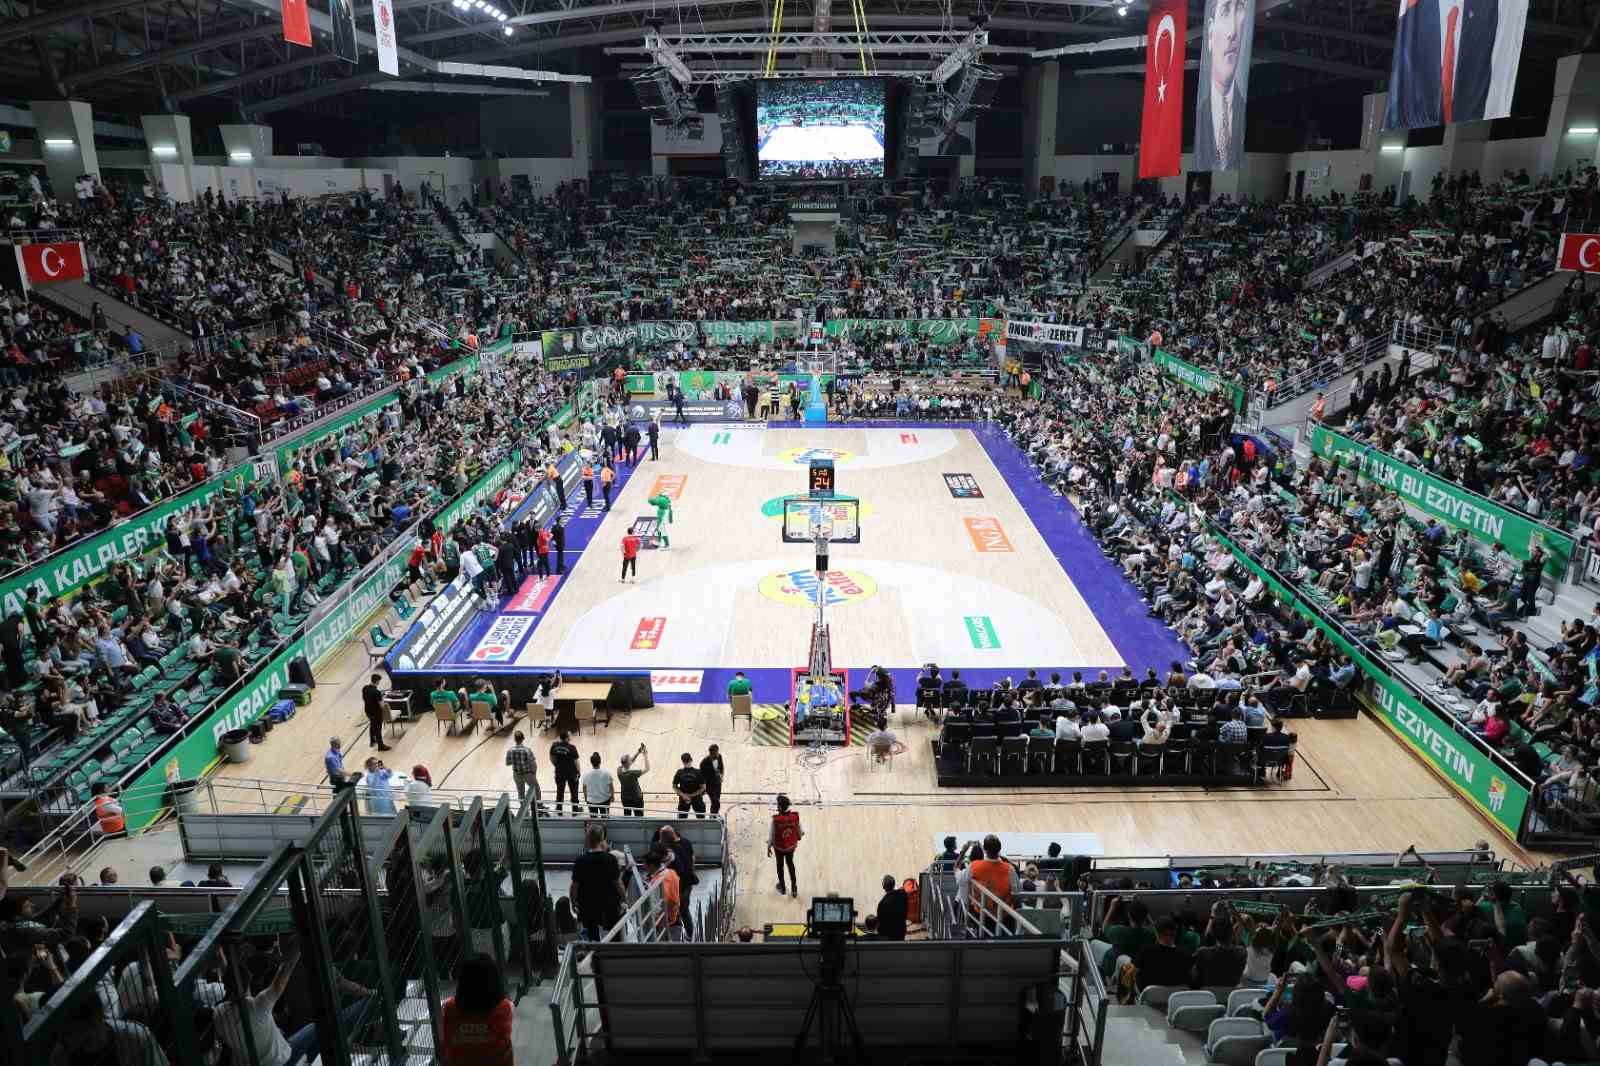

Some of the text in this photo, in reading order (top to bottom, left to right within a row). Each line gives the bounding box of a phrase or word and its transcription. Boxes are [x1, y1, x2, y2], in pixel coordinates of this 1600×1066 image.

[814, 476, 829, 490] 24
[1400, 473, 1423, 500] BU
[54, 525, 150, 593] KALPLER
[1396, 701, 1475, 784] EZİYETİN
